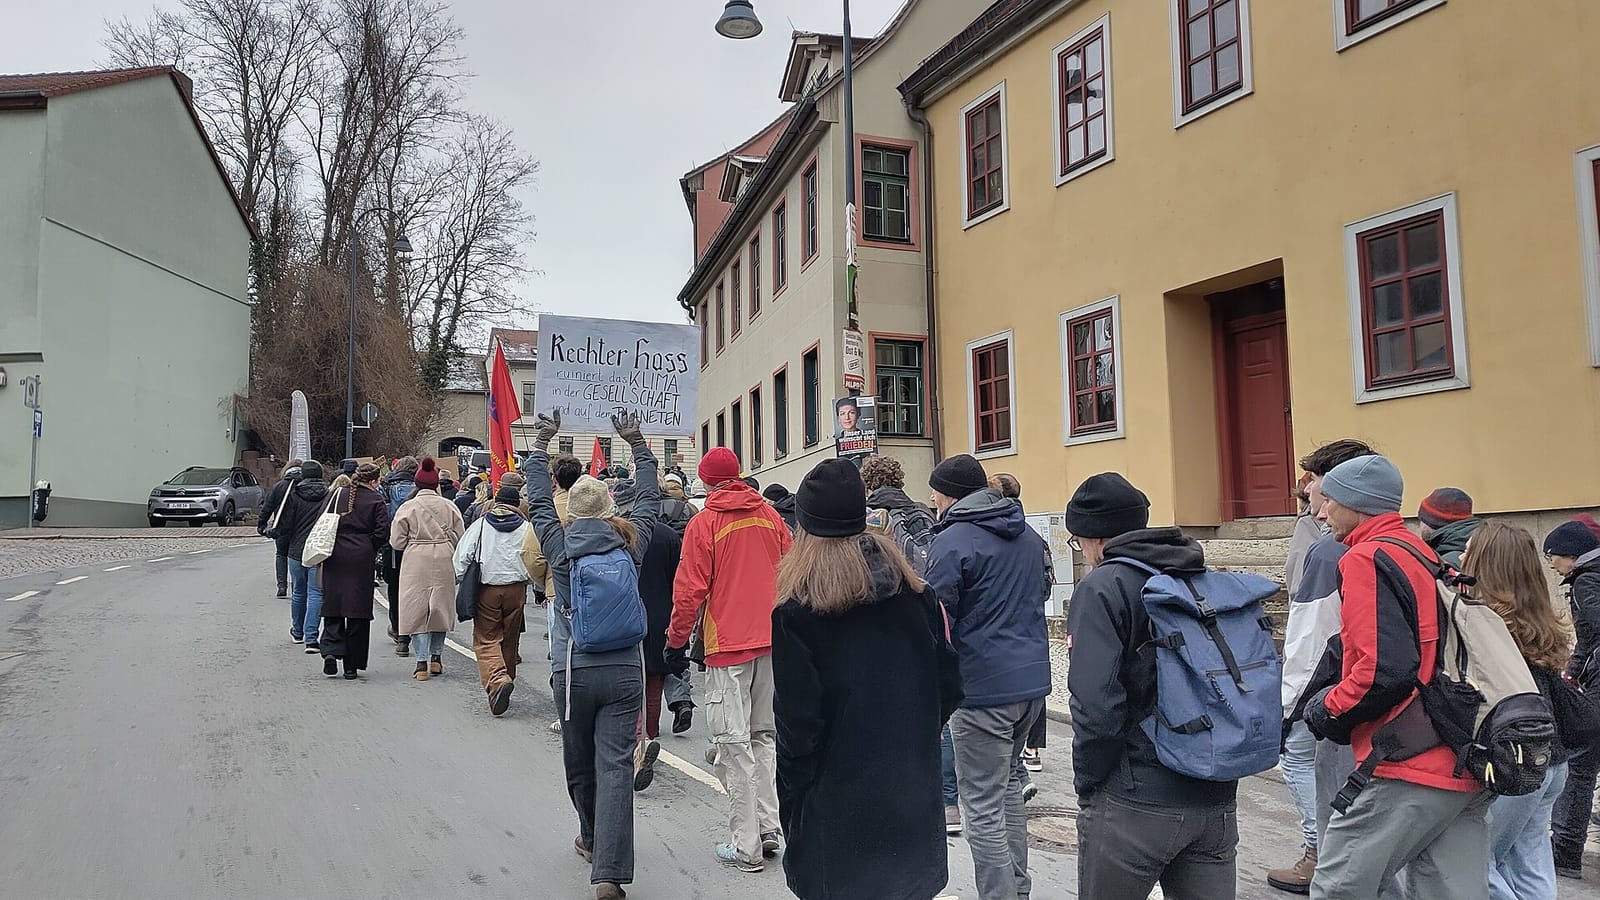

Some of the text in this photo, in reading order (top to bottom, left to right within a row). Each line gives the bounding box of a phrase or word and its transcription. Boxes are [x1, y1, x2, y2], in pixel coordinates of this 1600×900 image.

[550, 333, 628, 366] Rechter
[556, 368, 678, 393] ruiniert das KLIMA
[552, 384, 681, 413] in der GESELLSCHAFT
[574, 403, 592, 421] auf
[595, 404, 612, 418] dem
[861, 428, 876, 436] Land
